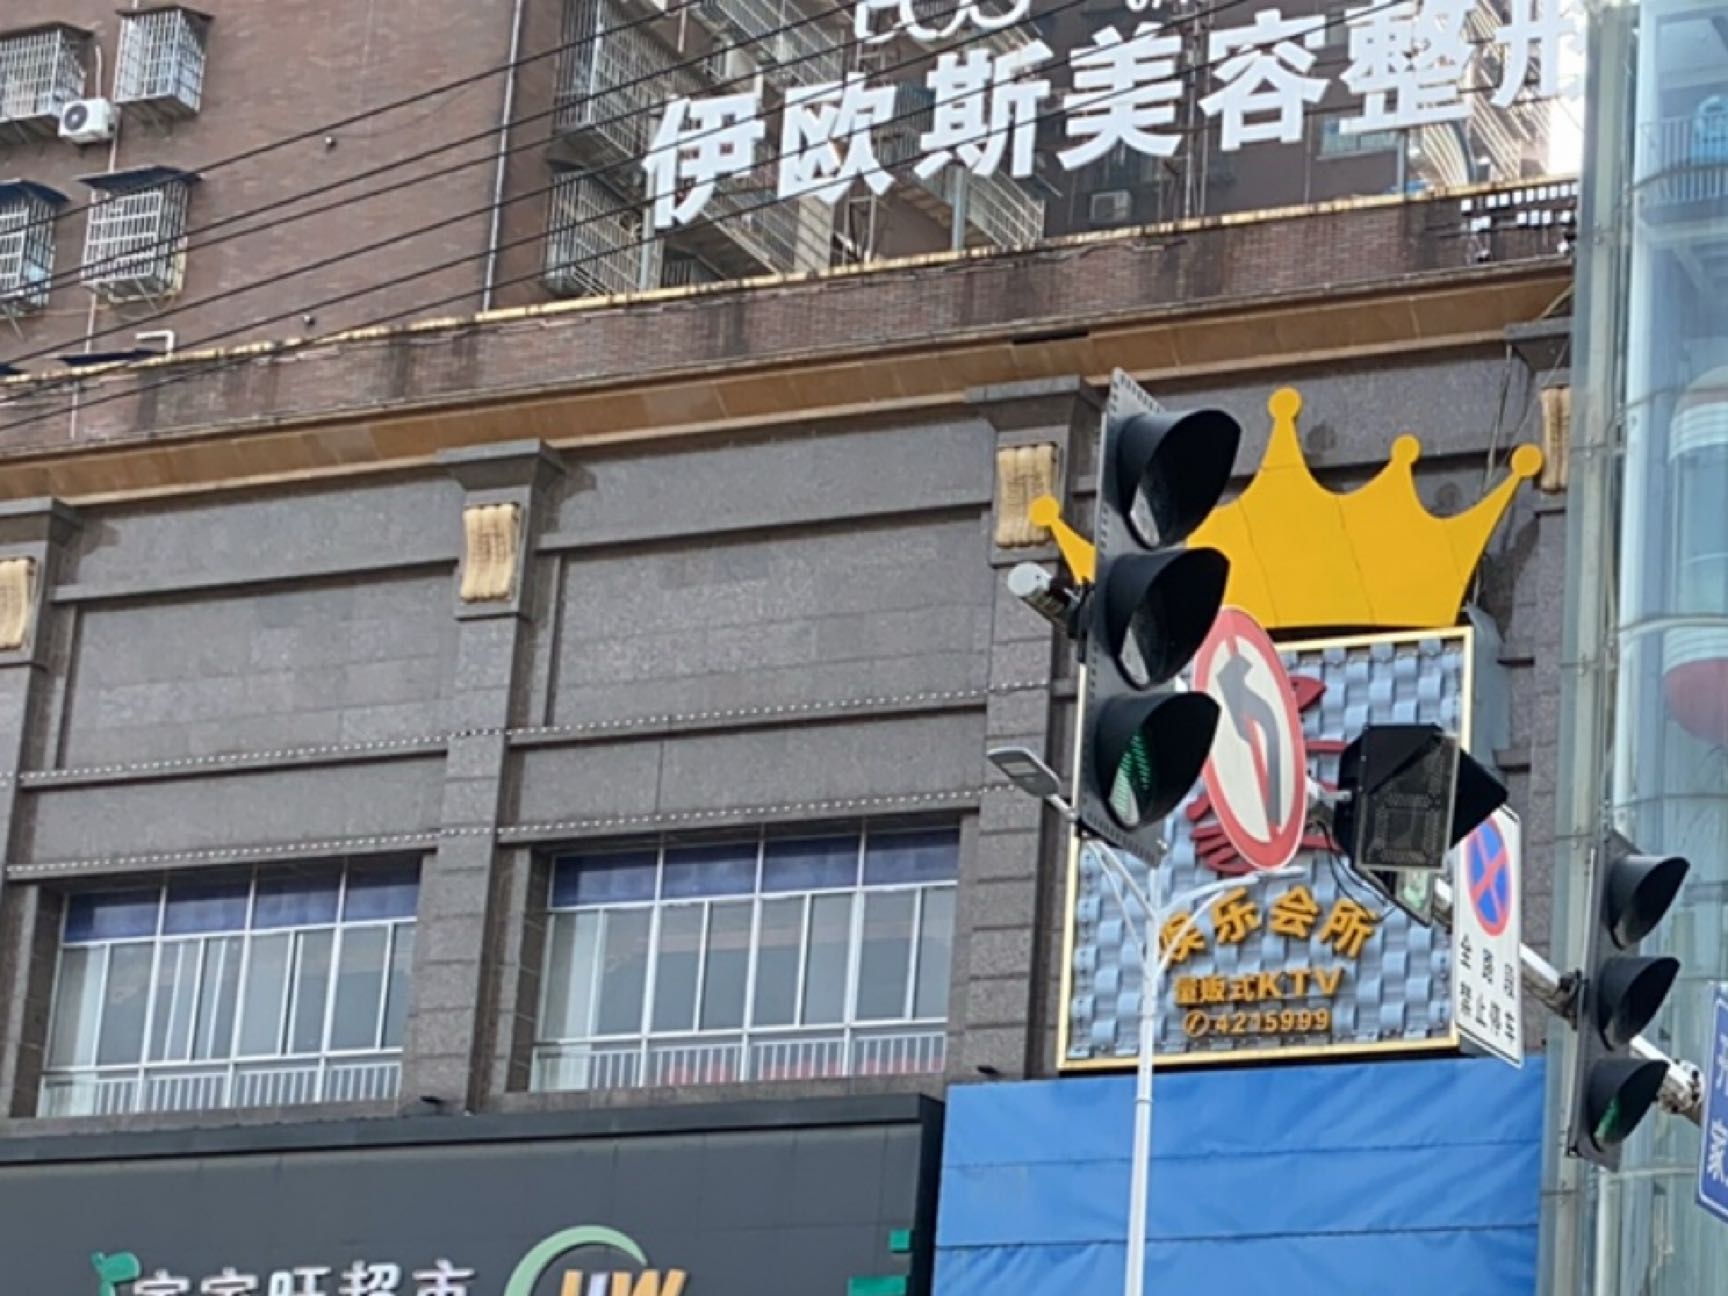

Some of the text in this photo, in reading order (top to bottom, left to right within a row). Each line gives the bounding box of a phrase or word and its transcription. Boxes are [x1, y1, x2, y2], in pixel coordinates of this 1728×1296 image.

[641, 0, 1584, 229] 伊欧斯美容整形
[1160, 885, 1379, 965] 娱乐会所
